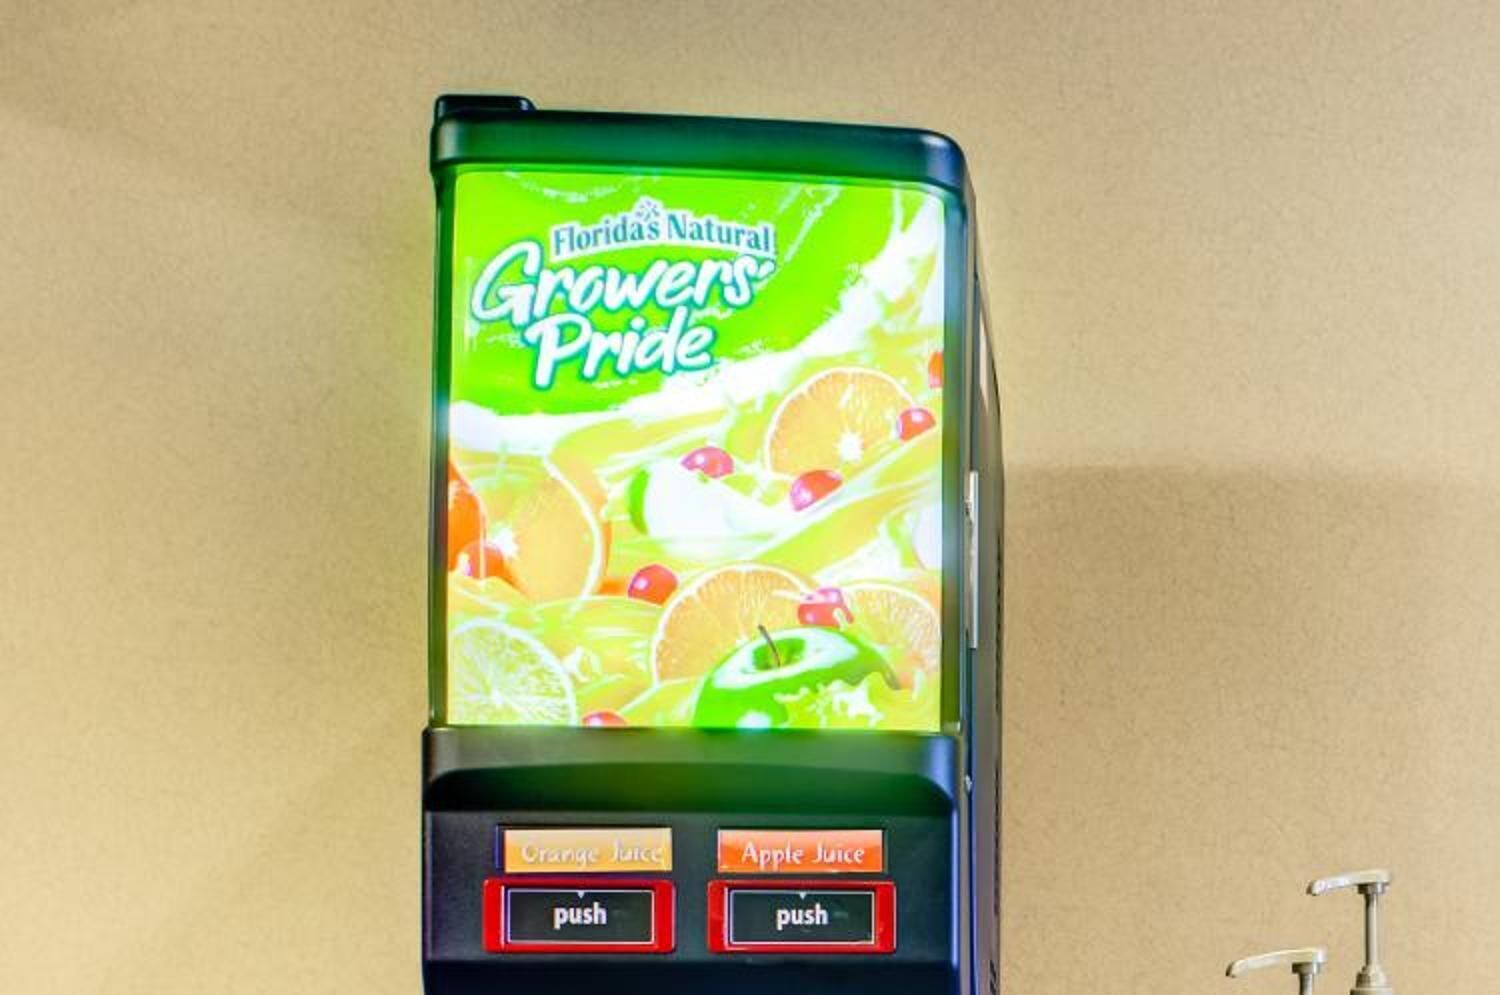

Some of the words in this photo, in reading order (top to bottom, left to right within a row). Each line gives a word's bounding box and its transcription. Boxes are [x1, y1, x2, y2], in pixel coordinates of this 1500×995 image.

[667, 212, 771, 252] Natural
[523, 306, 715, 389] Pride
[520, 841, 598, 866] Orange
[610, 840, 664, 864] Juice
[740, 841, 803, 869] Apple
[812, 841, 866, 865] Juice
[553, 902, 607, 930] push
[775, 902, 829, 931] push
